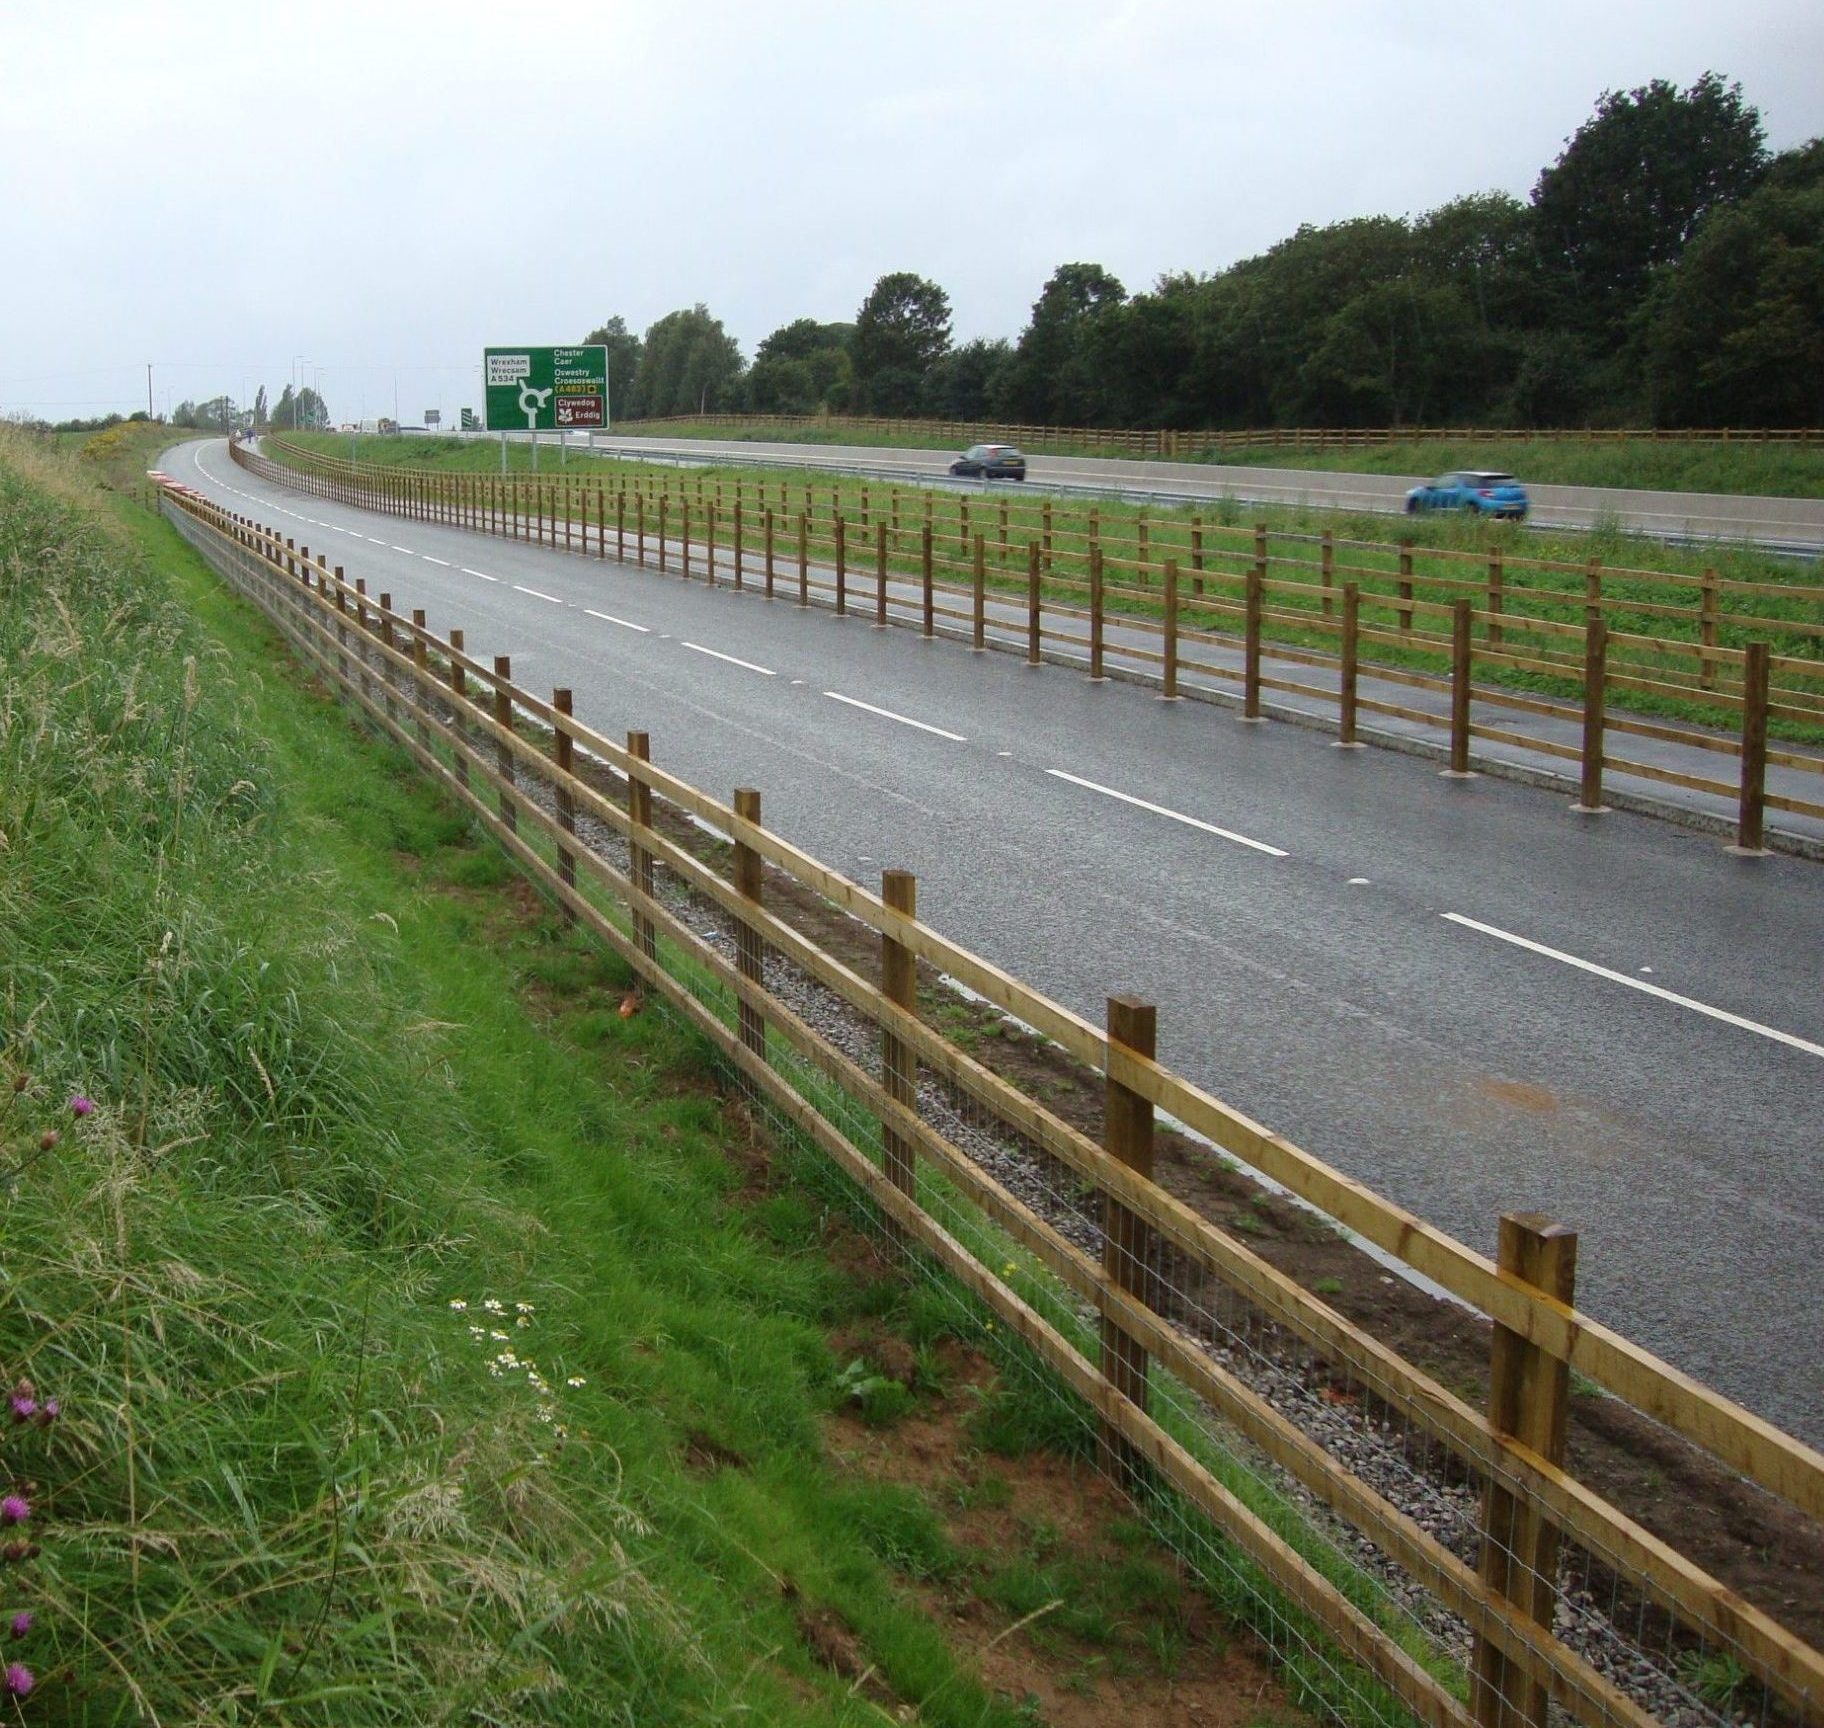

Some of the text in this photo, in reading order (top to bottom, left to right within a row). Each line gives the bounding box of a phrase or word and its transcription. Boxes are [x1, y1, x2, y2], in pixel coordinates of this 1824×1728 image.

[554, 349, 584, 357] Chester
[491, 358, 527, 366] Wrexham
[554, 369, 590, 377] Oswestry
[558, 399, 596, 408] Clywedog
[575, 411, 600, 419] Erddig
